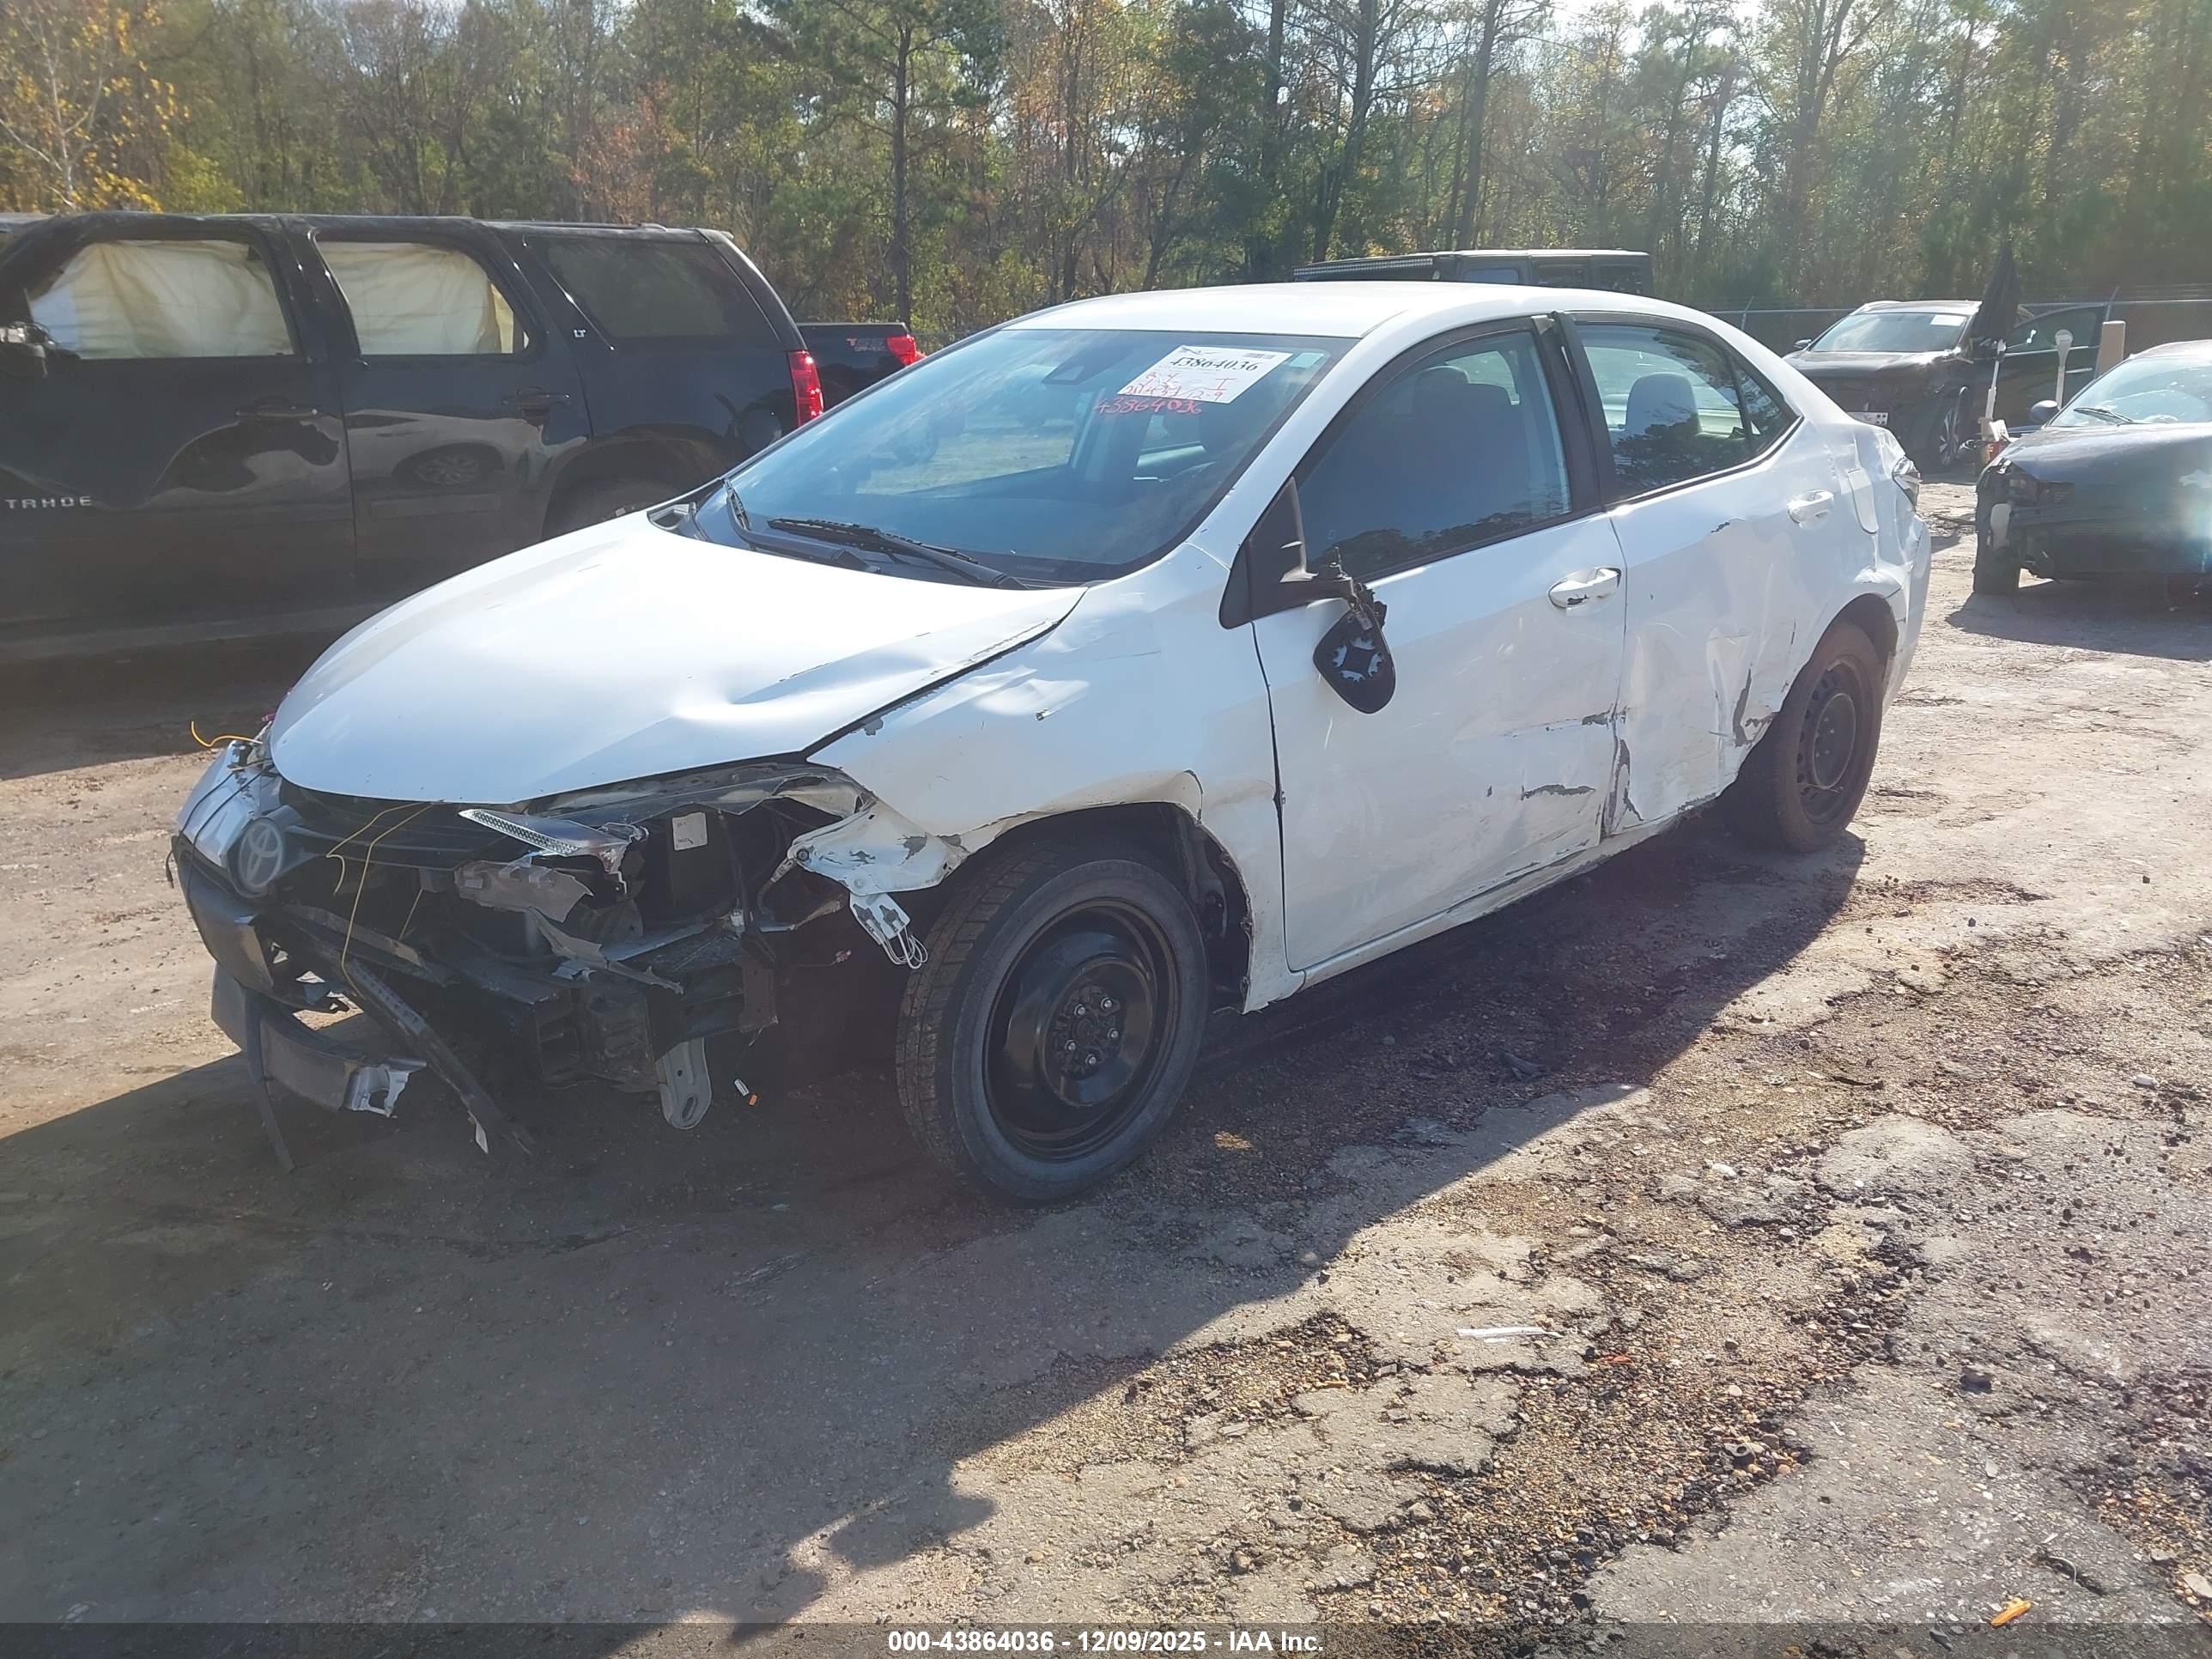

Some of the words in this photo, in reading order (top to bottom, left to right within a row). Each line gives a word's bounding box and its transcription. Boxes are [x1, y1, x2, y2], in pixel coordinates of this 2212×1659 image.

[574, 329, 586, 338] LT
[1170, 356, 1263, 372] 43864036
[5, 495, 93, 509] TAHOE
